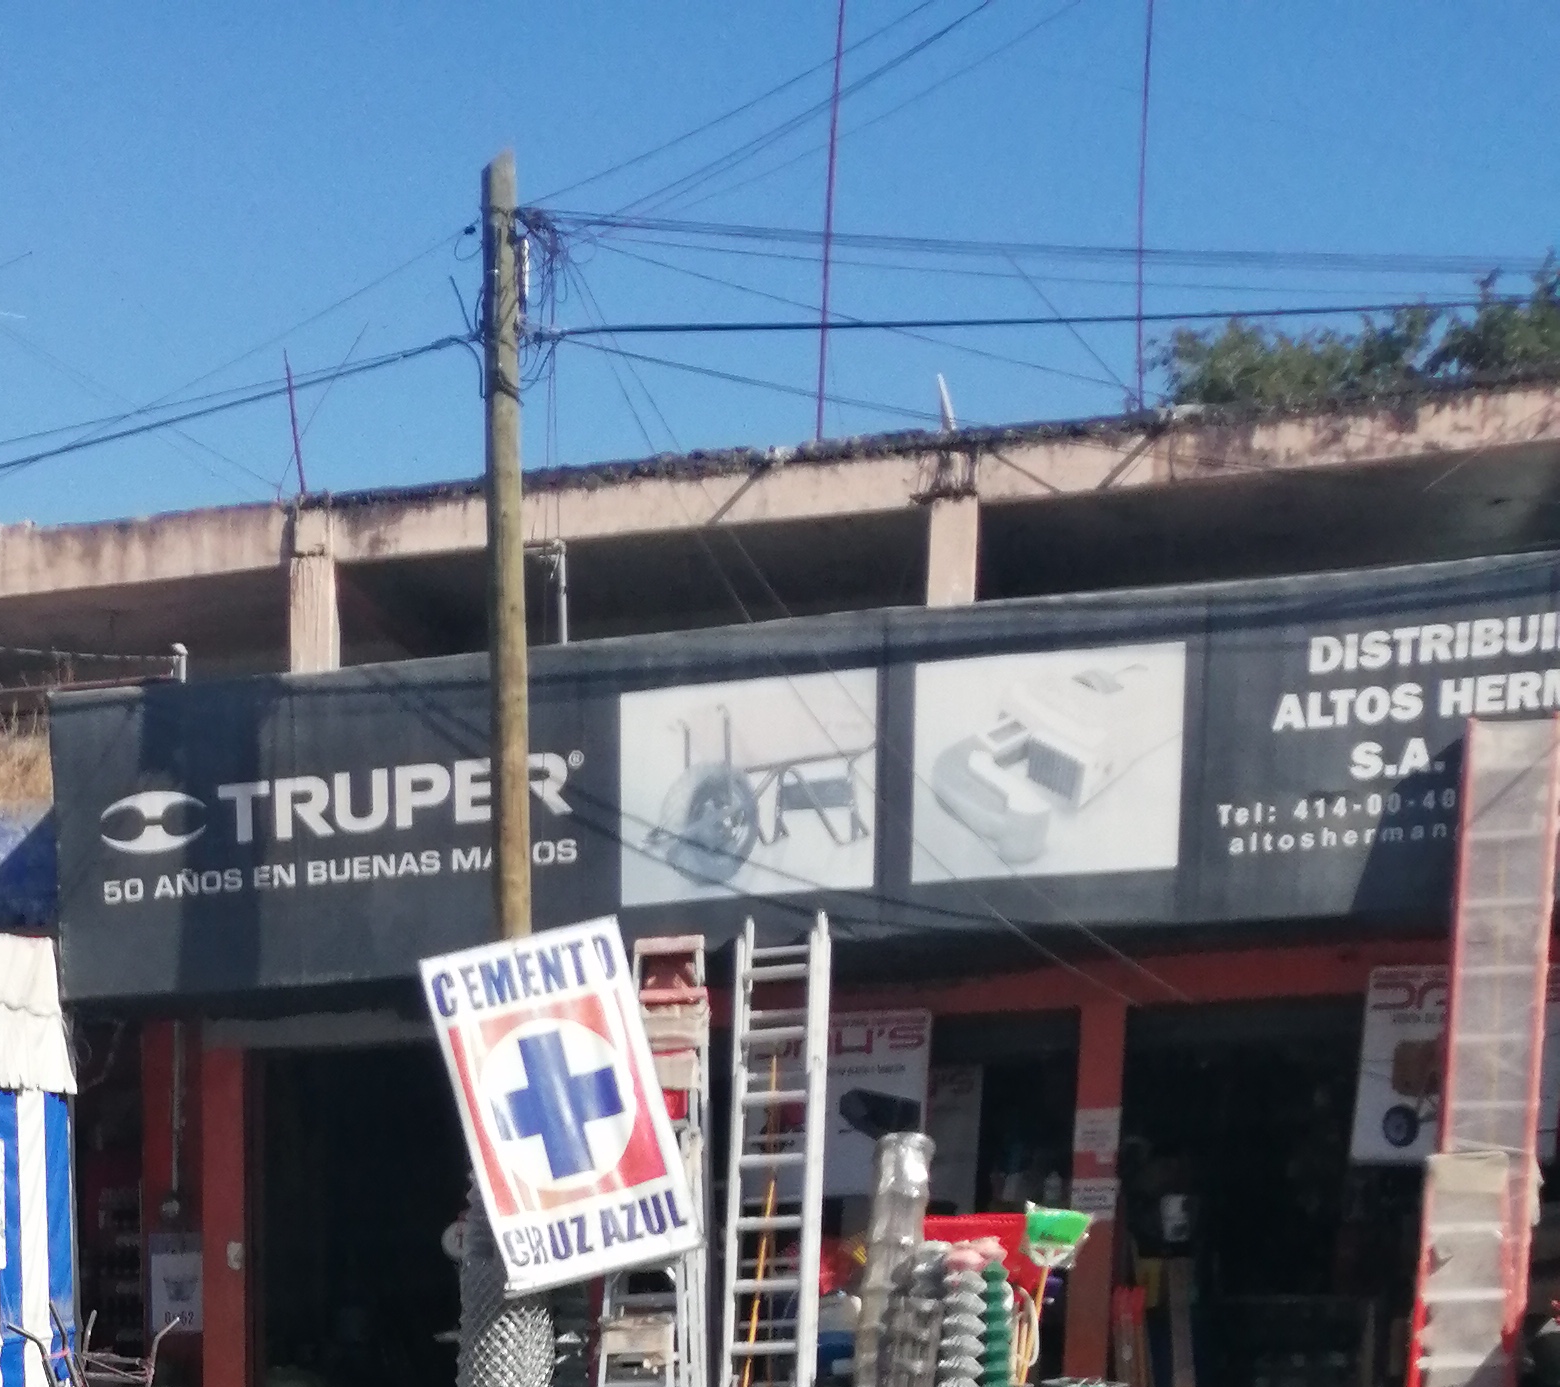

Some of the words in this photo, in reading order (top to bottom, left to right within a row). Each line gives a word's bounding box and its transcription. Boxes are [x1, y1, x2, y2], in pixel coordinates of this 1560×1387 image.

[1308, 612, 1560, 674] DISTRIBUI
[1272, 682, 1424, 732] ALTOS
[1349, 737, 1446, 780] S.A.
[217, 750, 575, 845] TRUPER
[1217, 801, 1277, 827] Tel:
[1229, 823, 1464, 856] altosherman
[102, 876, 144, 904] 50
[154, 865, 243, 900] AÑOS
[252, 861, 296, 888] EN
[306, 849, 441, 884] BUENAS
[451, 838, 578, 871] MOS
[502, 1213, 594, 1266] CRUZ
[600, 1188, 687, 1248] AZUL
